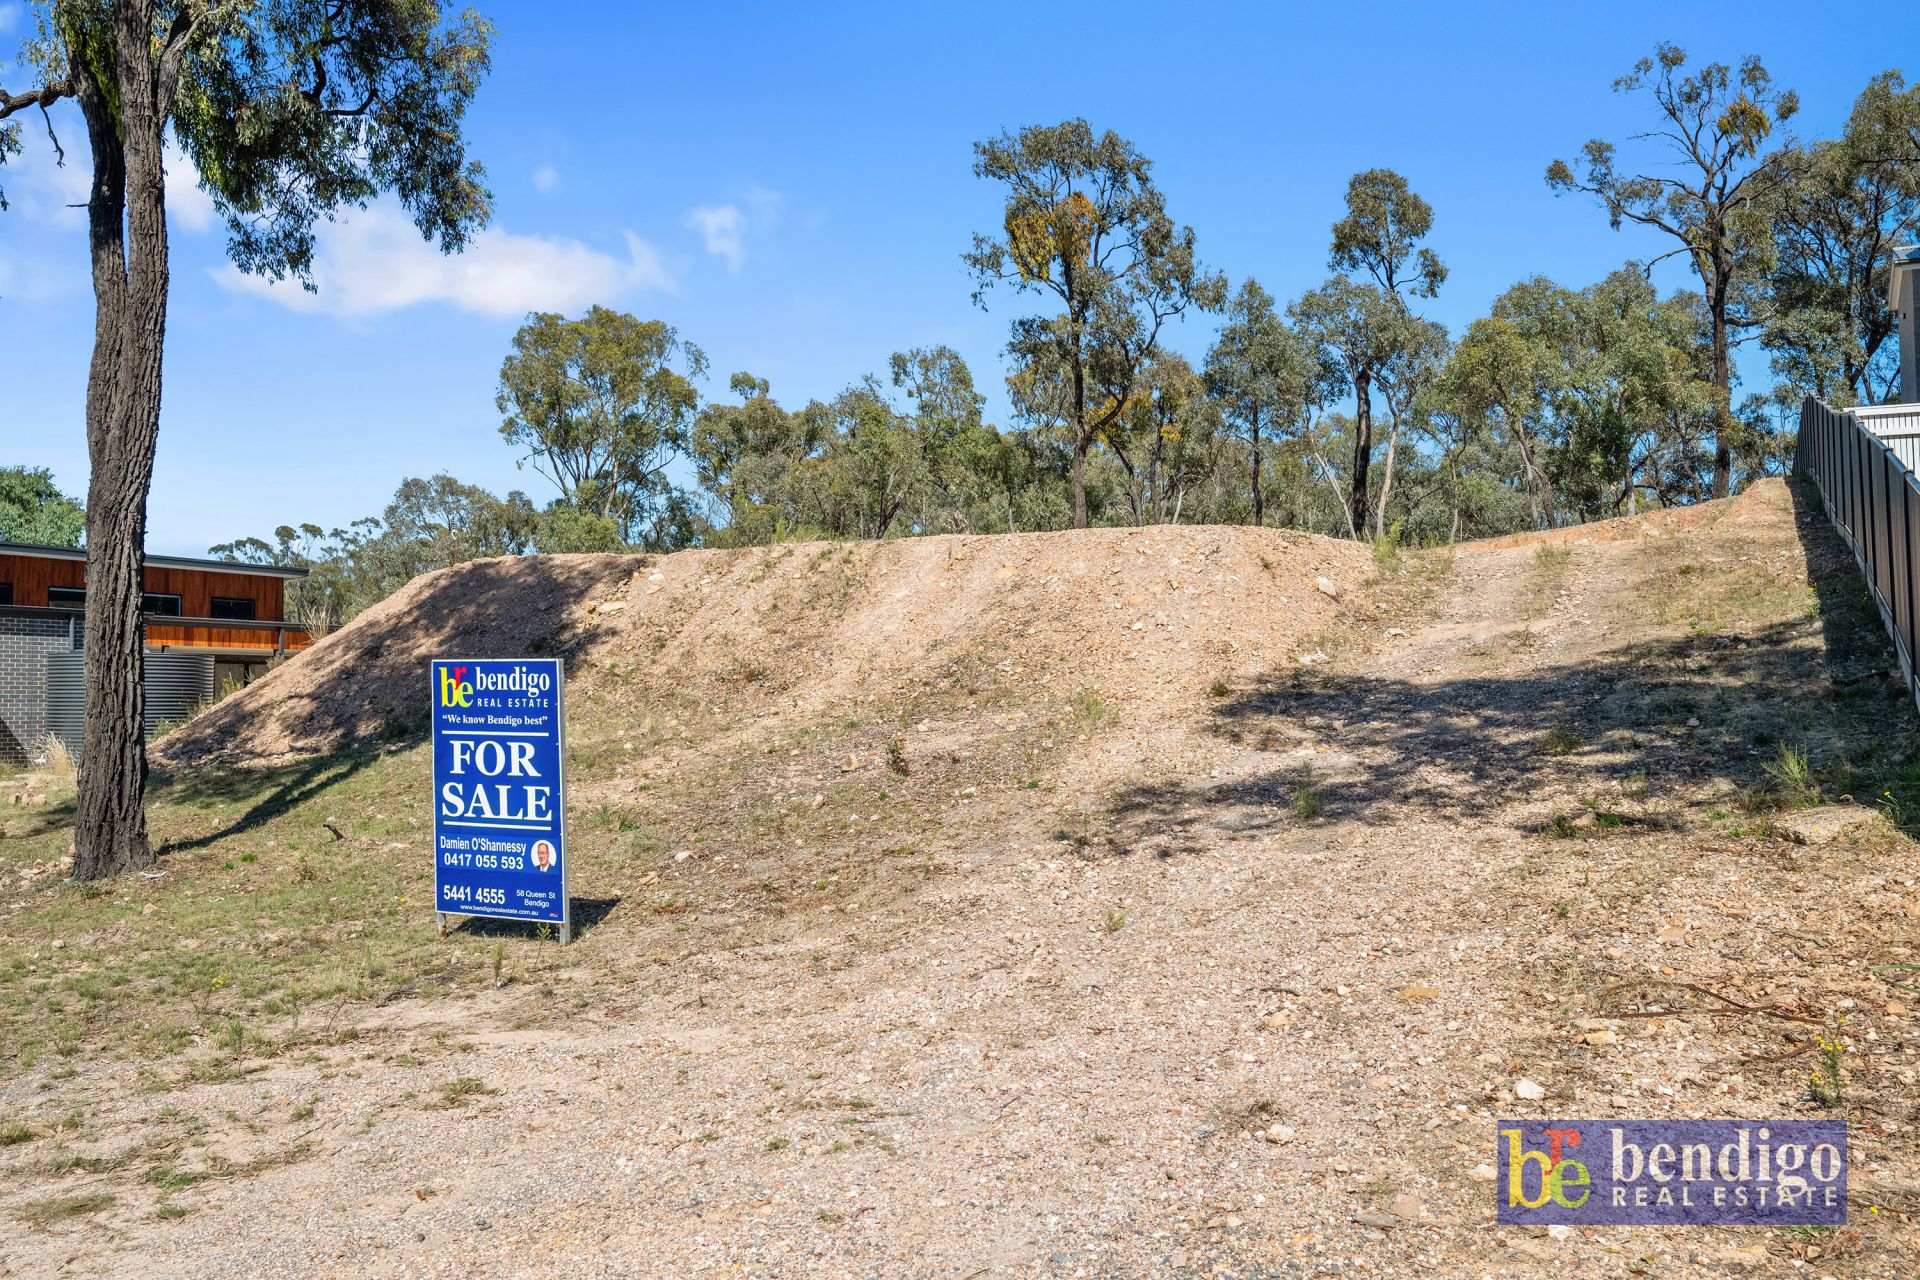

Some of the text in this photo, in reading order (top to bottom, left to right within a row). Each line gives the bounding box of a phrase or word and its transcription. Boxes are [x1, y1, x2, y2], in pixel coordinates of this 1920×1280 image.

[475, 666, 550, 698] bendigo
[477, 698, 548, 708] REAL ESTATE
[462, 714, 485, 724] know
[487, 715, 522, 727] Bendigo
[449, 740, 542, 777] FOR
[442, 781, 552, 821] SALE
[440, 836, 470, 850] Damien
[444, 853, 524, 870] 0417 055 593
[443, 885, 505, 905] 5441 4555
[525, 890, 547, 899] Queen
[548, 891, 556, 899] St
[460, 904, 539, 916] www.bendigorealestate.com.au
[524, 899, 550, 909] Bendigo
